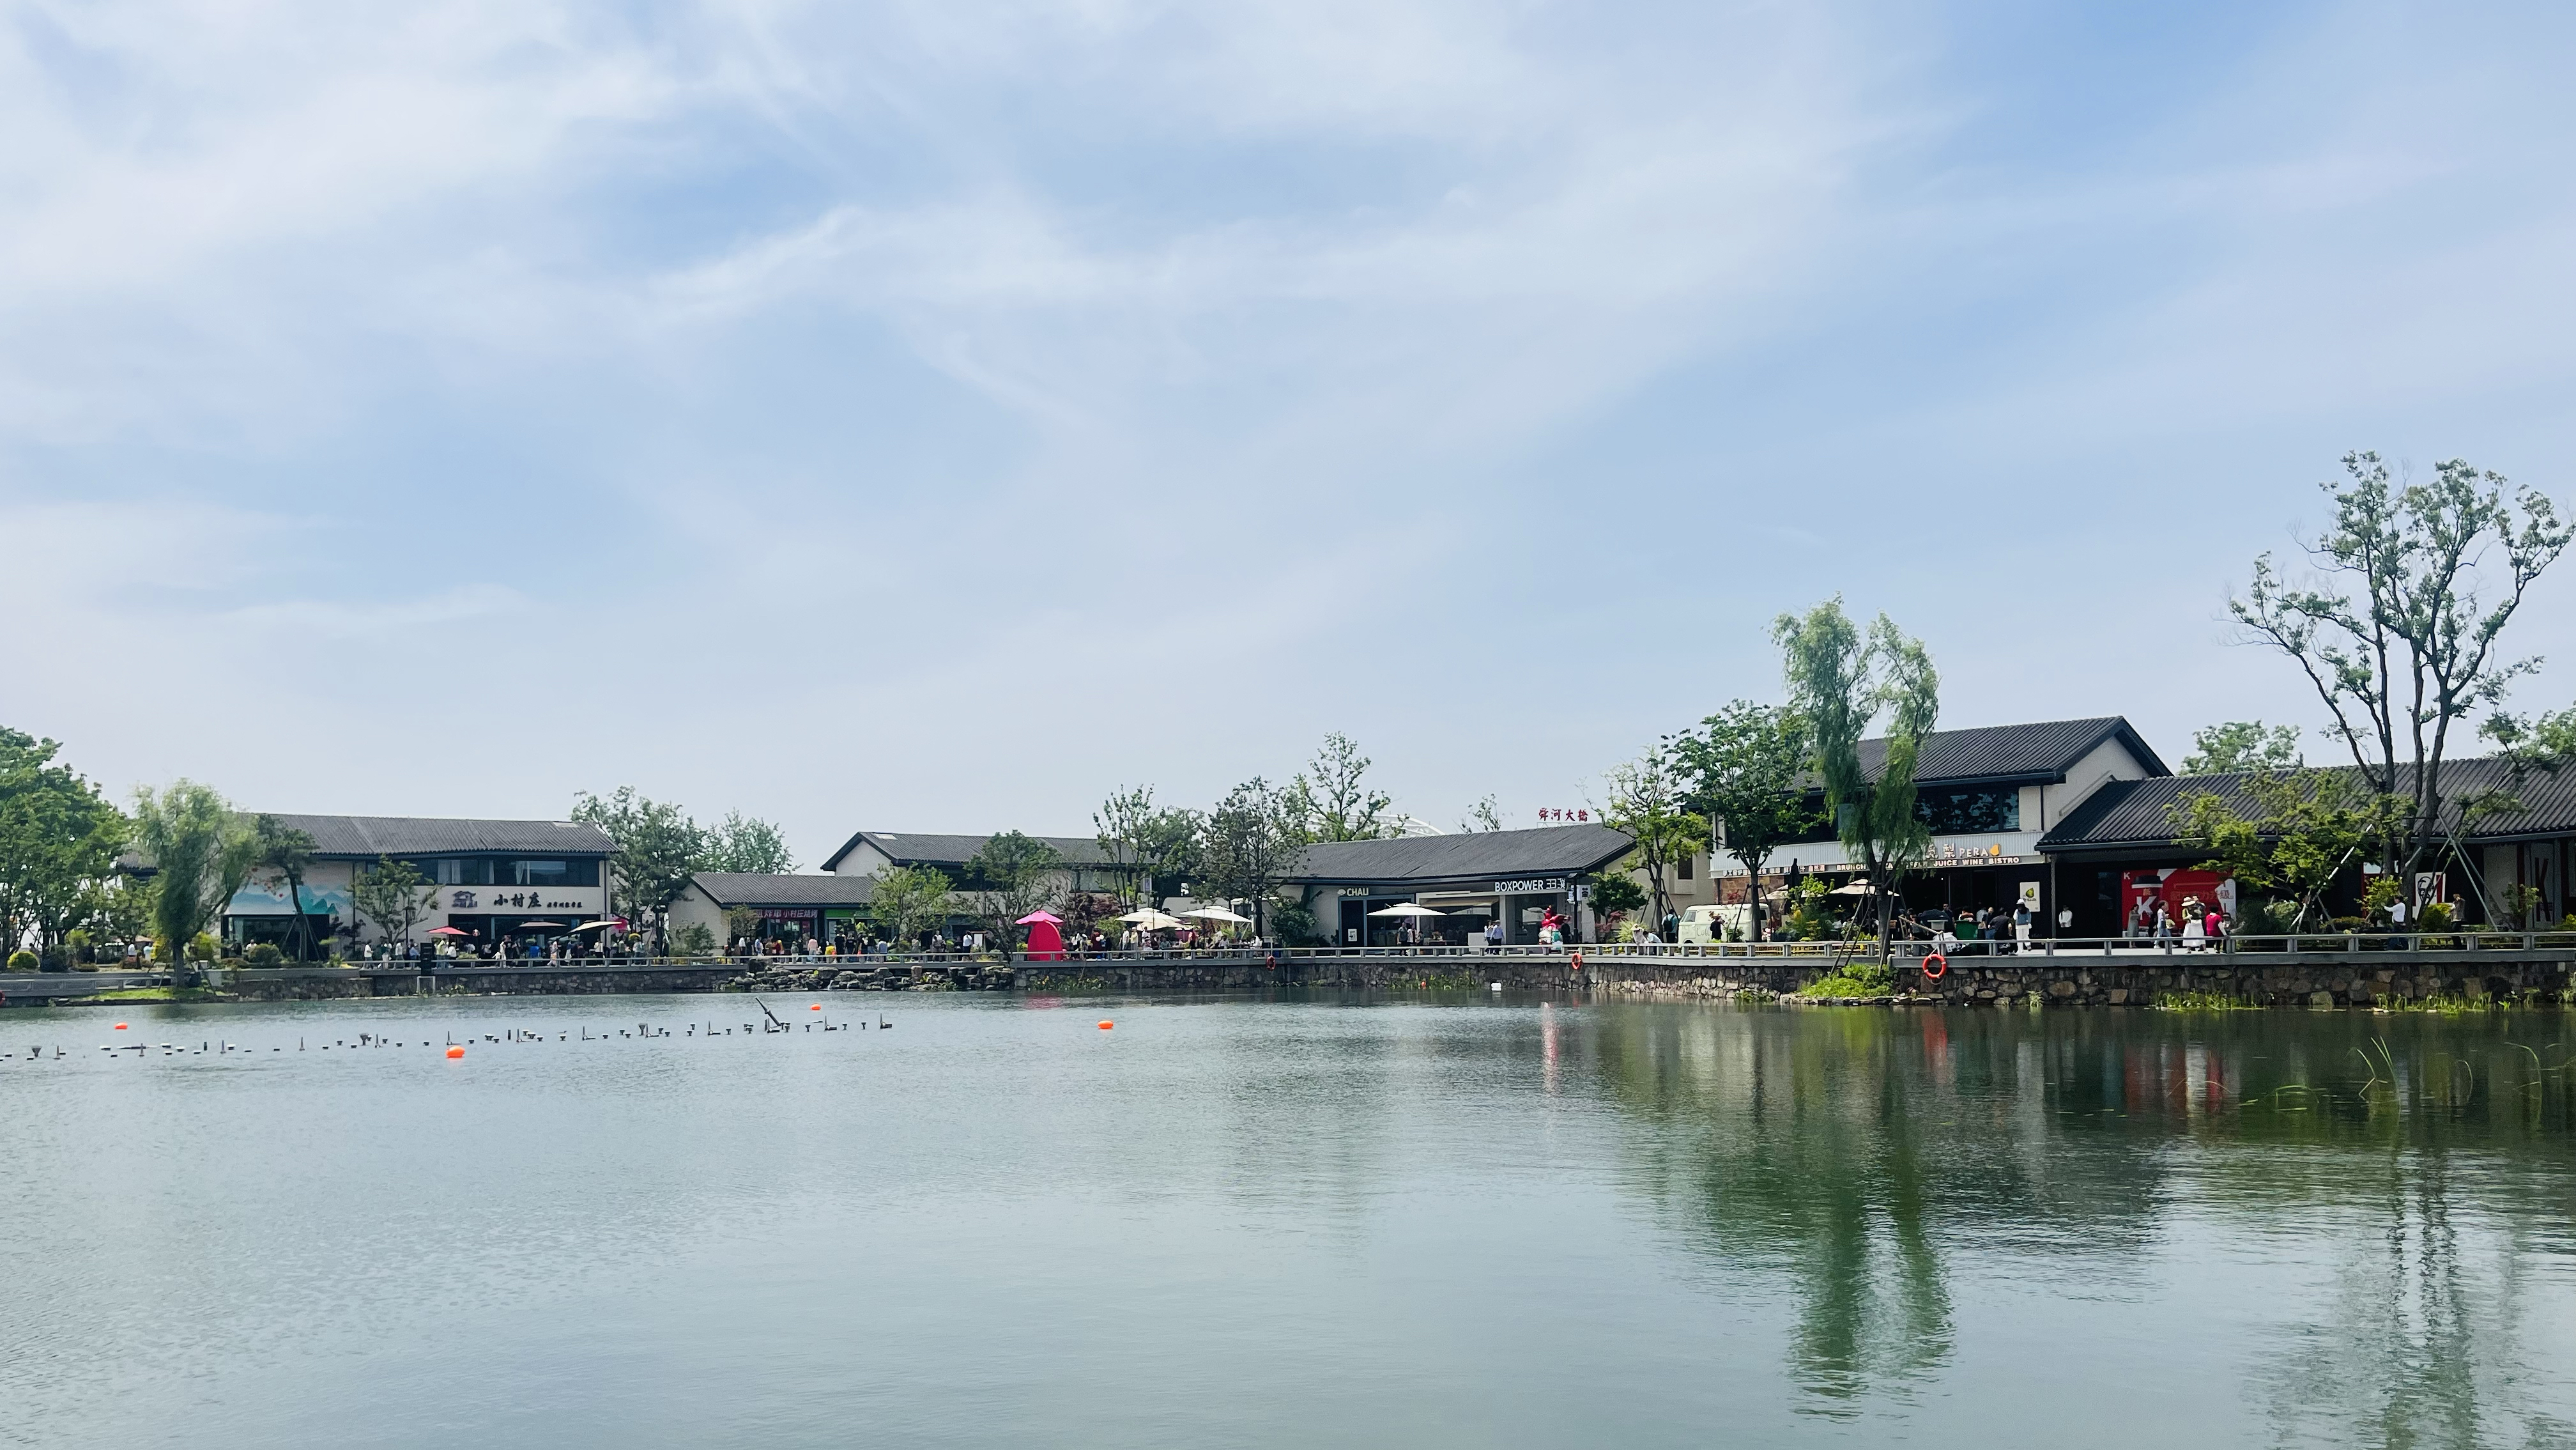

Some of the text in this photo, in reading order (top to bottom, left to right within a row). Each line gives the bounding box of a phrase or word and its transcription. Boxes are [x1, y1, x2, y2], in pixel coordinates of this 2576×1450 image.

[1959, 847, 1989, 858] PERA
[1933, 859, 1958, 867] JUICE
[1988, 856, 2020, 865] BISTRO
[2123, 872, 2131, 880] K
[1494, 879, 1544, 893] BOXPOWER
[493, 891, 542, 909] 小村庄
[2136, 896, 2157, 921] K
